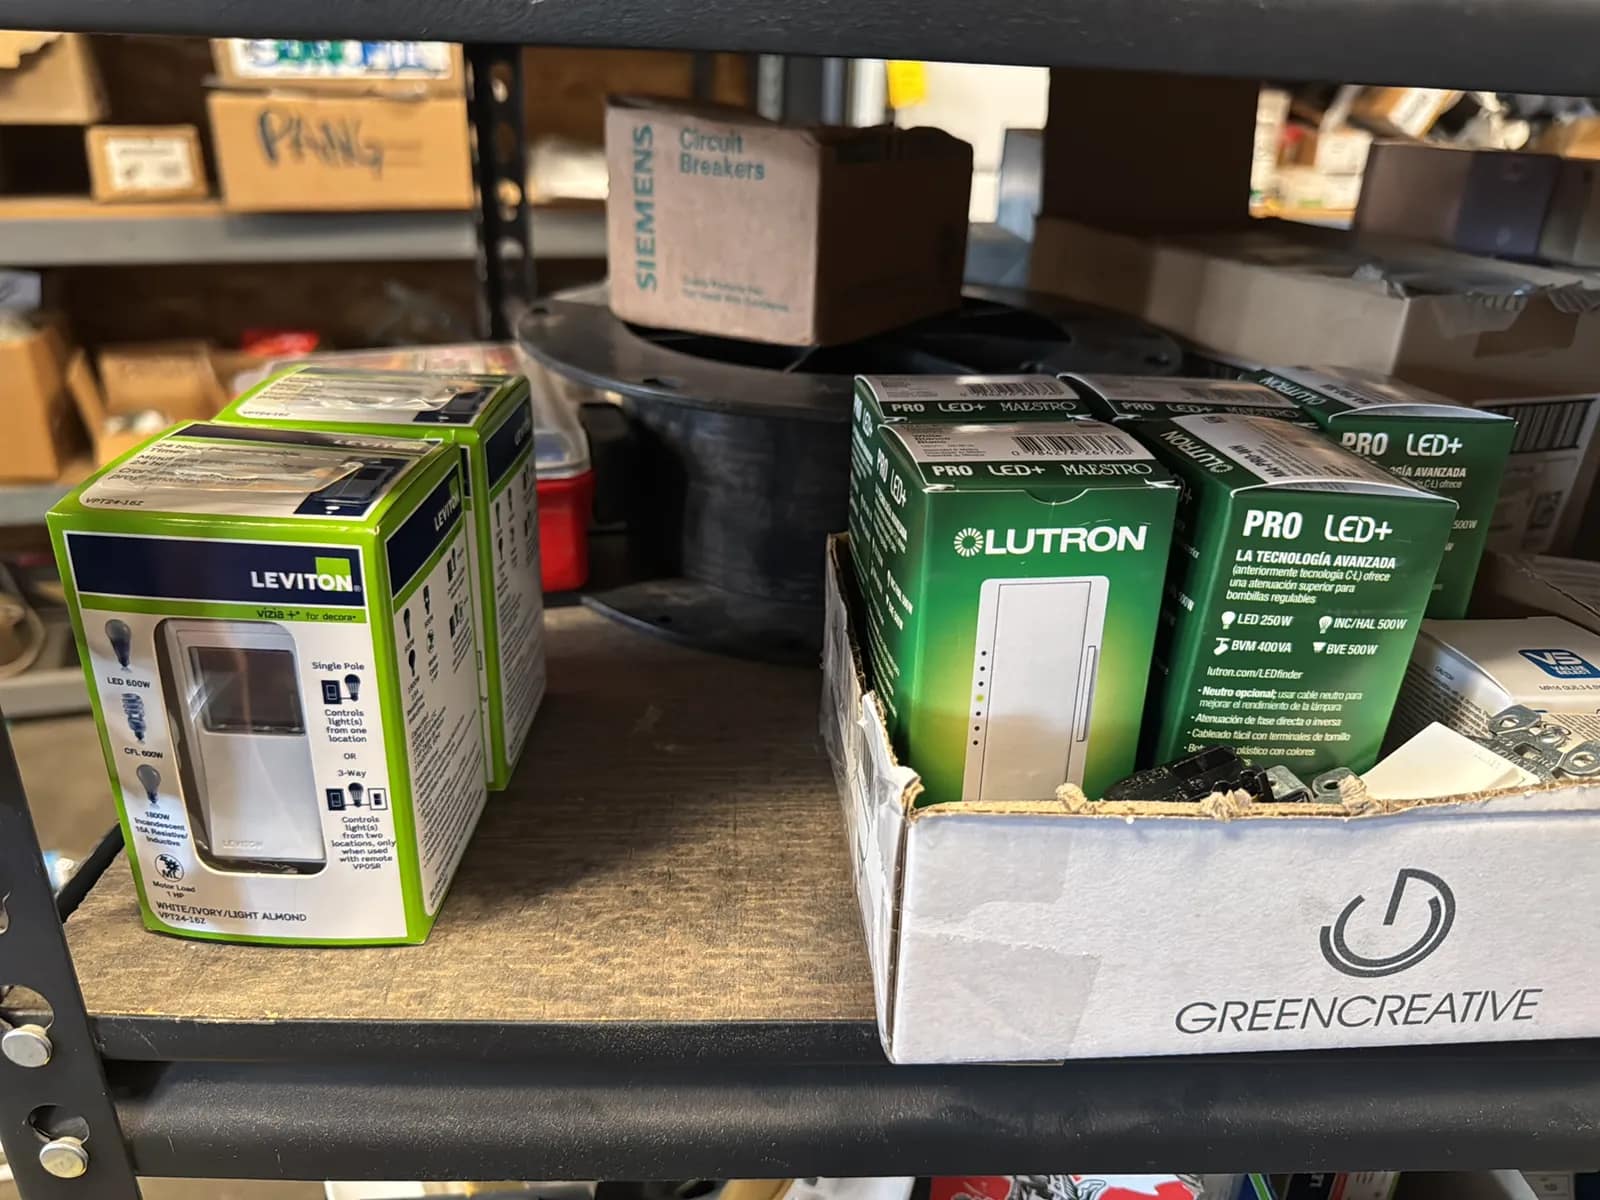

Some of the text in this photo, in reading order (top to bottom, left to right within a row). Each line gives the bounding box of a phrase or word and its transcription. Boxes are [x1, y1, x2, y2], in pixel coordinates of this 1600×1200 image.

[679, 127, 743, 154] Circuit
[679, 154, 766, 181] Breakers
[632, 124, 657, 293] SIEMENS
[891, 401, 1077, 413] PRO LED+ MAESTRO
[1122, 402, 1155, 412] PRO
[1341, 432, 1388, 455] PRO
[1406, 433, 1463, 456] LED+
[931, 463, 1153, 477] PRO LED+ MAESTRO
[1414, 467, 1467, 478] AVANZADA
[1242, 509, 1393, 543] PRO LED+
[984, 525, 1147, 555] LUTRON
[1235, 549, 1397, 569] LA TECNOLOGÍA AVANZADA
[1232, 564, 1298, 578] (anteriormente
[1363, 571, 1391, 582] ofrece
[250, 570, 354, 593] LEVITON
[1229, 578, 1356, 595] una atenuación superior para
[1226, 591, 1317, 605] bombillas regulables
[257, 607, 284, 620] vizia
[306, 612, 319, 621] for
[1237, 613, 1408, 630] LED 250W INC/HAL 500W
[1231, 640, 1379, 655] BVM 400VA BVE 500W
[312, 661, 365, 671] Single Pole
[1207, 666, 1304, 681] lutron.com/LEDfinder
[106, 677, 150, 689] LED 600W
[1202, 686, 1234, 698] Neutro
[1277, 690, 1296, 699] usar
[1297, 690, 1319, 699] cable
[1320, 691, 1345, 699] neutro
[1345, 692, 1363, 701] para
[1199, 699, 1232, 709] mejorar
[1233, 700, 1241, 709] el
[1242, 701, 1289, 710] rendimiento
[1290, 702, 1301, 710] de
[1302, 702, 1310, 710] la
[325, 709, 364, 717] Controls
[1195, 713, 1244, 725] Atenuación
[1244, 716, 1256, 724] de
[1257, 717, 1275, 725] fase
[1276, 717, 1305, 726] directa
[1312, 718, 1342, 727] inversa
[328, 718, 362, 726] light(s)
[326, 726, 348, 734] from
[1191, 728, 1232, 739] Cableado
[1251, 732, 1268, 740] con
[1269, 731, 1312, 741] terminales
[1312, 732, 1323, 741] de
[1324, 732, 1351, 742] tornillo
[124, 747, 164, 759] CFL 600W
[1269, 747, 1286, 756] con
[1286, 747, 1316, 756] colores
[337, 770, 366, 778] 3-Way
[345, 824, 378, 832] light(s)
[152, 881, 196, 893] Motor Load
[262, 911, 307, 922] ALMOND
[1175, 988, 1543, 1034] GREENCREATIVE
